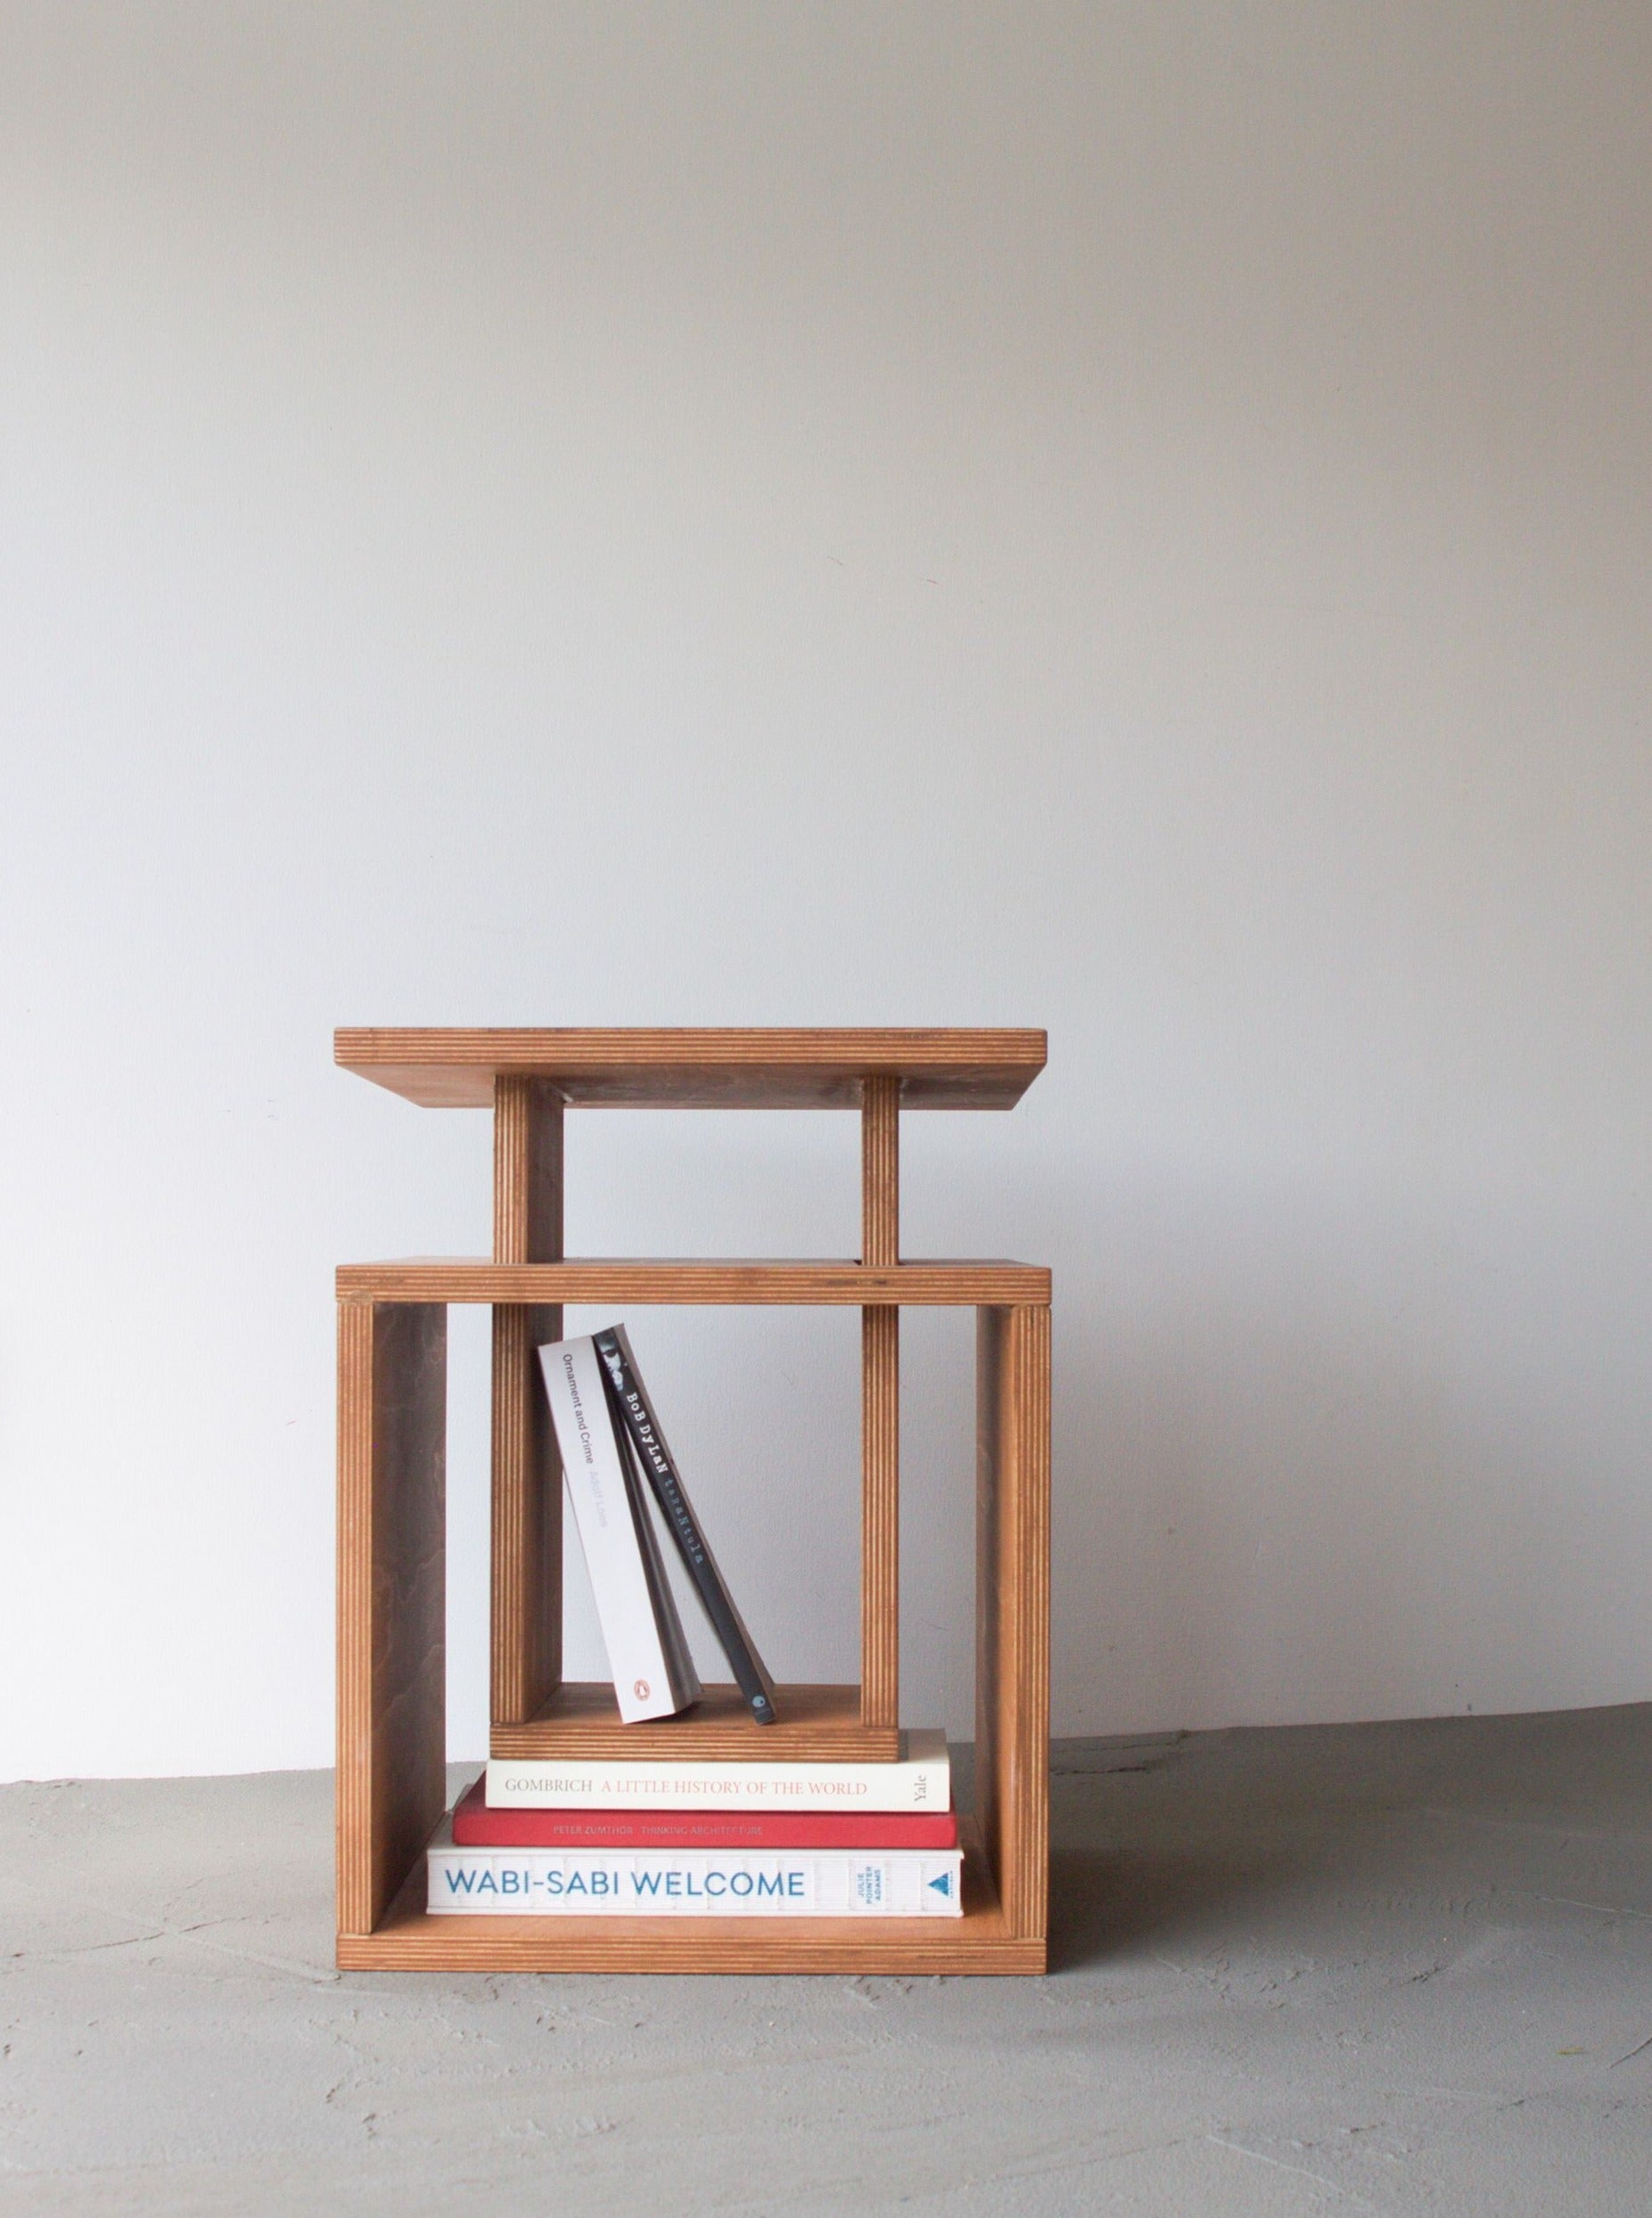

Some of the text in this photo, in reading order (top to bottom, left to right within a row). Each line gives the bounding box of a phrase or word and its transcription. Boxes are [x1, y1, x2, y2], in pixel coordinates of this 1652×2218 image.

[563, 1353, 594, 1464] Ornament and Crime
[505, 1778, 867, 1795] GOMBRICH A LITTLE HISTORY OF THE WORLD
[913, 1774, 927, 1803] Yale
[553, 1825, 582, 1835] PETER
[584, 1825, 633, 1835] ZUMTHOR
[445, 1869, 805, 1896] WABI-SABI WELCOME
[857, 1873, 865, 1897] JULIE
[865, 1866, 873, 1904] POINTER
[874, 1869, 882, 1901] ADAMS
